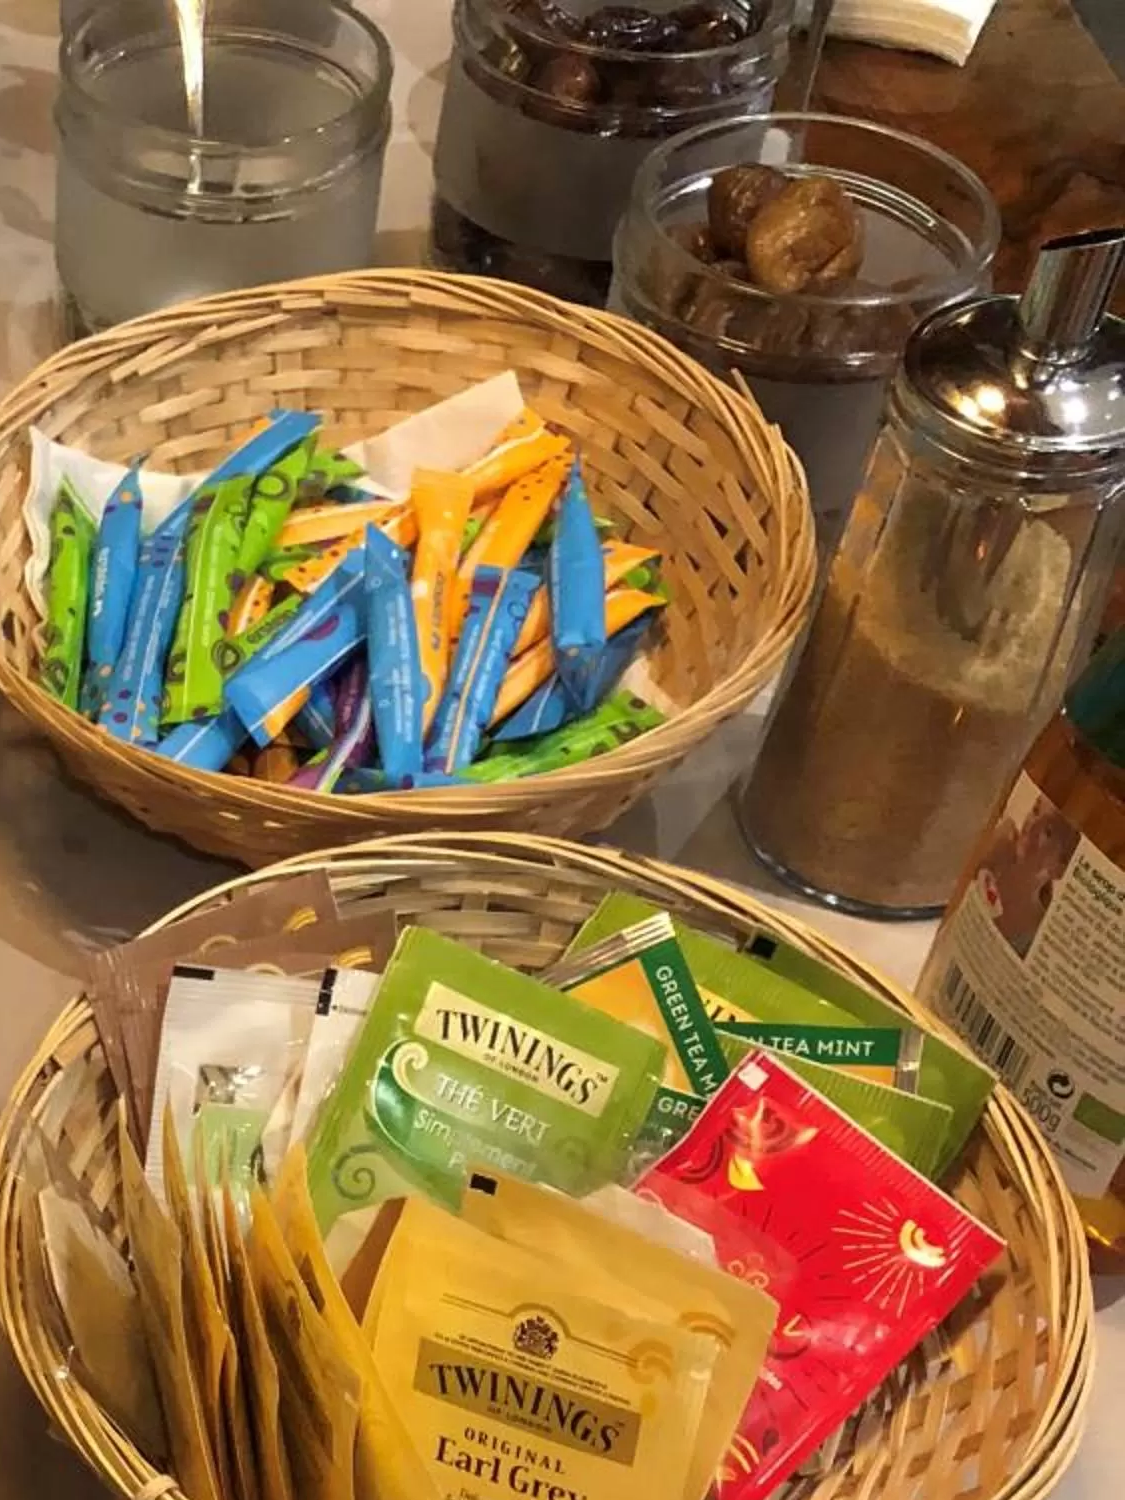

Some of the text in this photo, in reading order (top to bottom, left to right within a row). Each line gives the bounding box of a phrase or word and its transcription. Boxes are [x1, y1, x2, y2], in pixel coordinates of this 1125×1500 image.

[655, 965, 707, 1074] GREEN TEA
[817, 1038, 876, 1058] MINT
[435, 1009, 603, 1106] TWININGS
[434, 1071, 552, 1143] THÉ VERT
[658, 1097, 699, 1122] GRE
[429, 1362, 621, 1457] TWININGS
[436, 1437, 503, 1489] Earl
[464, 1426, 566, 1475] ORIGINAL
